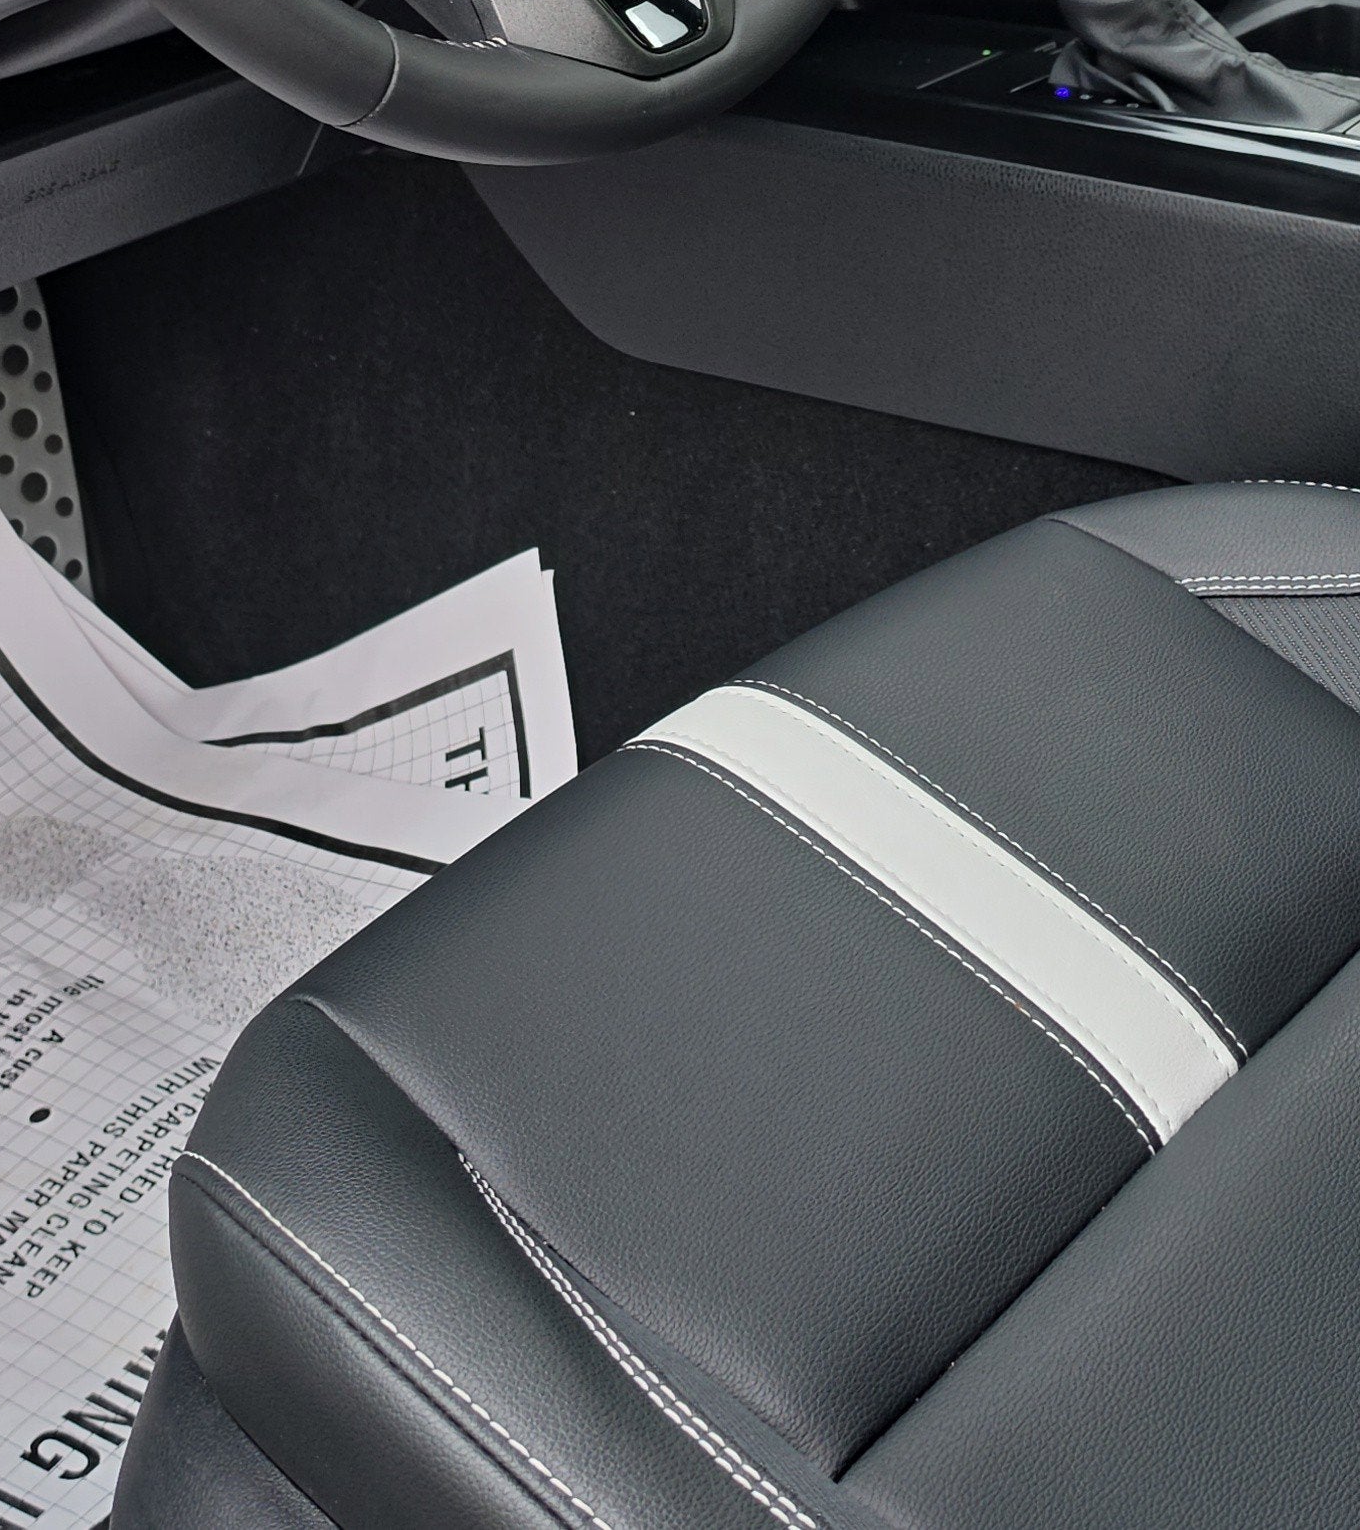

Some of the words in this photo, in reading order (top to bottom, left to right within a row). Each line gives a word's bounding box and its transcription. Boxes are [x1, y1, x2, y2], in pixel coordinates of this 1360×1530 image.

[6, 986, 38, 1008] in
[63, 973, 105, 998] the
[4, 994, 64, 1044] most
[41, 1027, 66, 1046] A
[155, 1055, 222, 1095] WITH
[102, 1094, 161, 1139] THIS
[25, 1139, 107, 1210] PAPER
[66, 1101, 197, 1210] CARPETING
[82, 1207, 125, 1236] TO
[25, 1238, 88, 1299] KEEP
